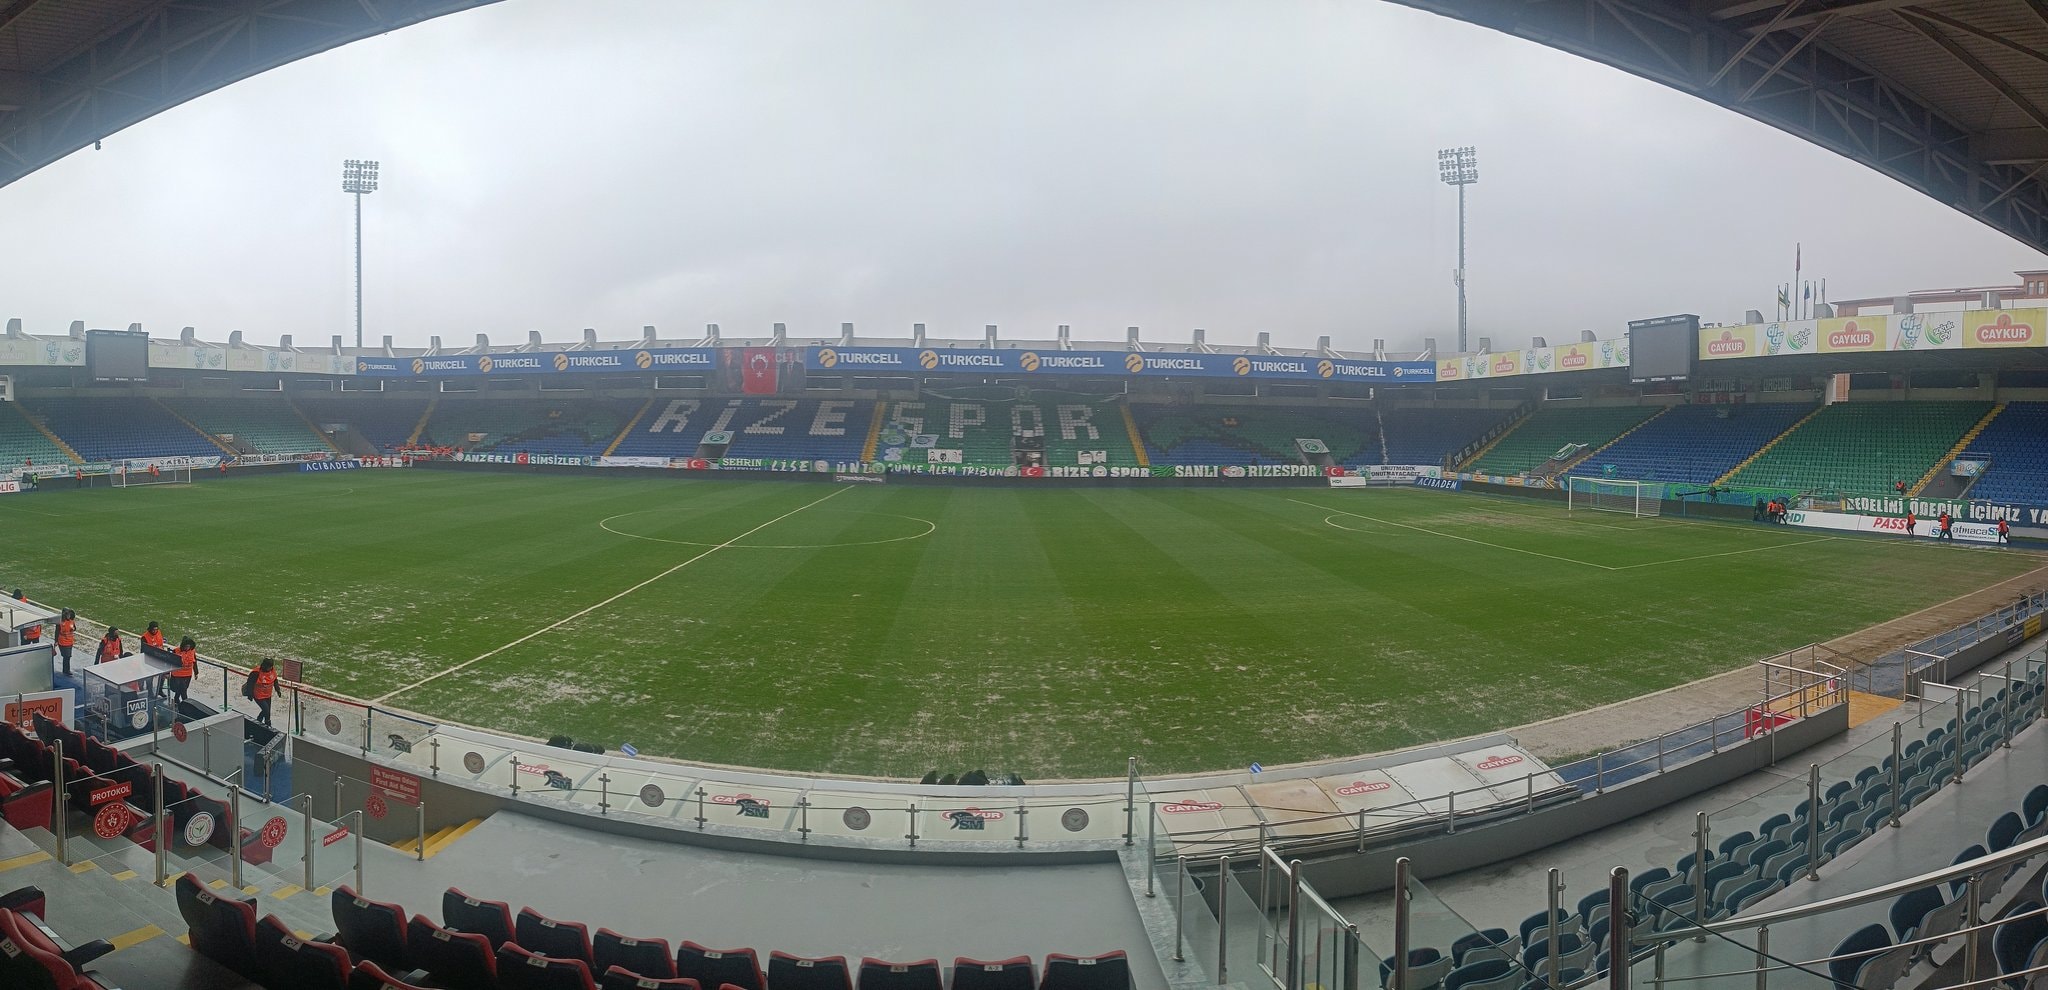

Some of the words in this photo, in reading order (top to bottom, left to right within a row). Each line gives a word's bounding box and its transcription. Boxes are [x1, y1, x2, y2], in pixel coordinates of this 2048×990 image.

[493, 358, 541, 368] TURKCELL
[569, 356, 621, 366] TURKCELL
[653, 354, 710, 364] TURKCELL
[838, 353, 902, 364] TURKCELL
[940, 355, 1004, 366] TURKCELL
[1041, 356, 1104, 368] TURKCELL
[425, 360, 467, 370] TURKCELL
[1145, 359, 1204, 370] TURKCELL
[1252, 361, 1307, 373] TURKCELL
[1335, 365, 1386, 377] TURKCELL
[0, 483, 15, 491] LİG
[2030, 509, 2048, 525] YA
[1873, 517, 1907, 530] PASS
[130, 702, 146, 711] VAR
[92, 785, 131, 801] PROTOKOL
[324, 829, 348, 844] PROTOKOL
[3, 941, 17, 953] D-7
[286, 938, 298, 950] C-7
